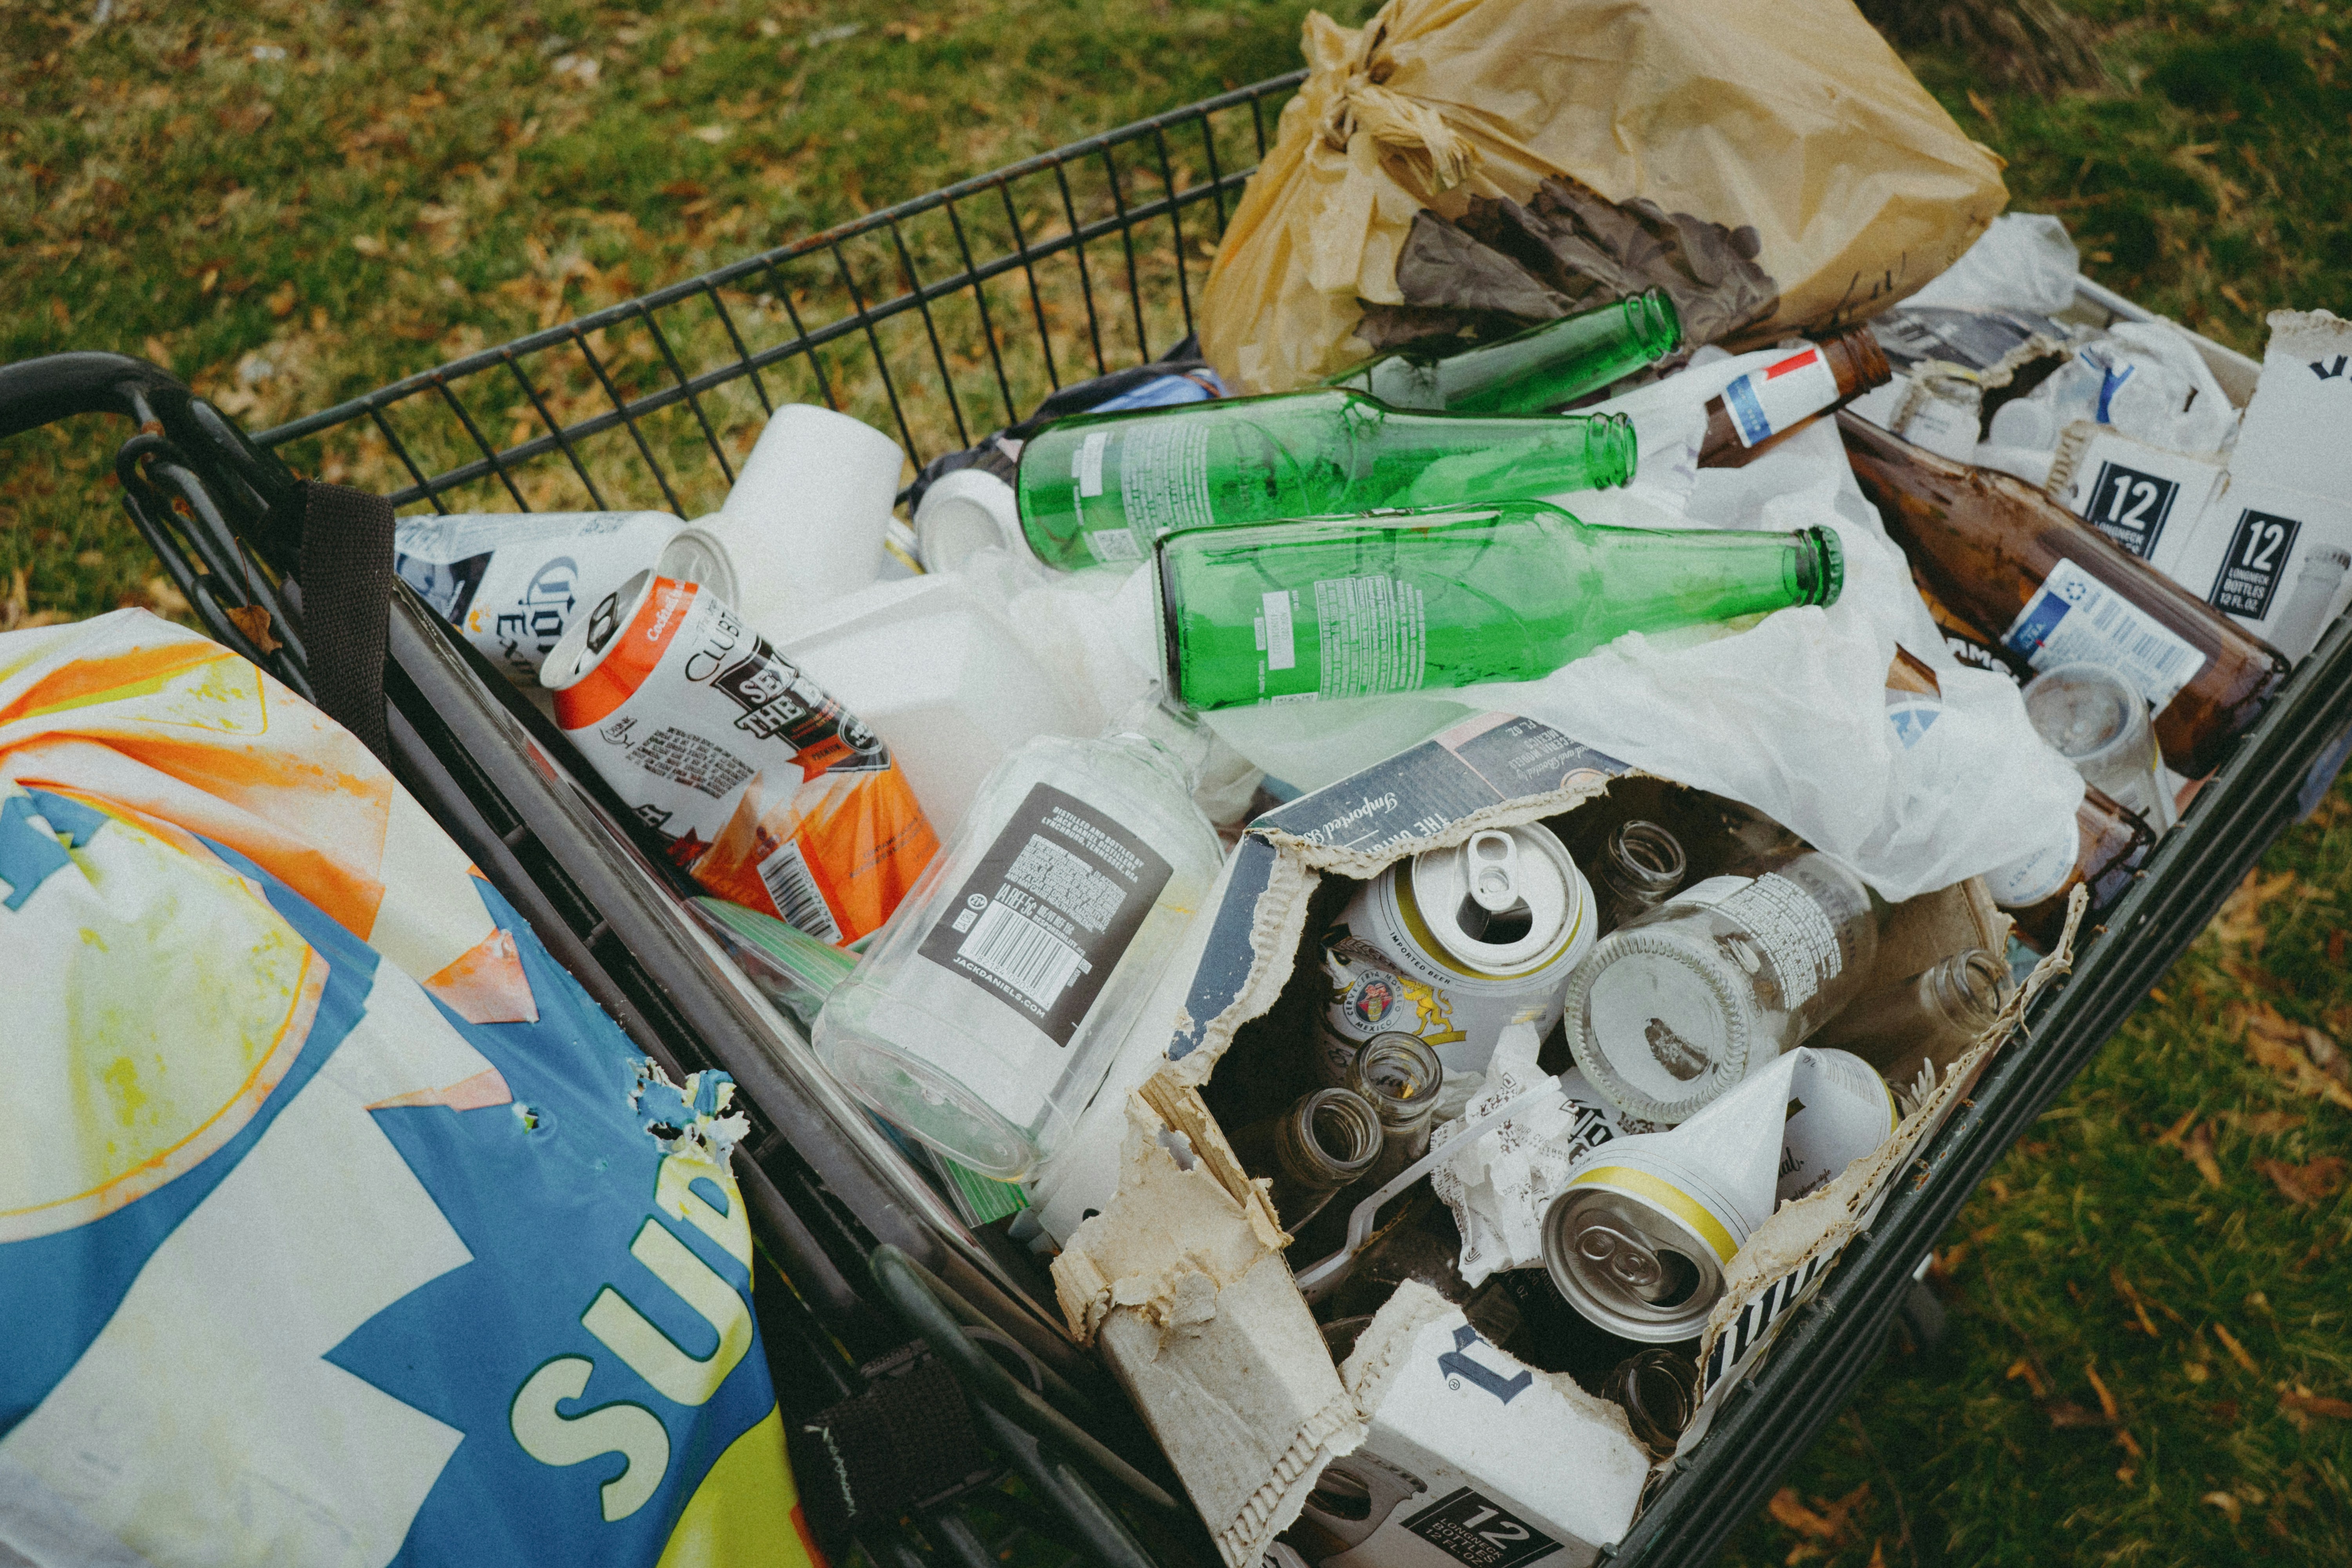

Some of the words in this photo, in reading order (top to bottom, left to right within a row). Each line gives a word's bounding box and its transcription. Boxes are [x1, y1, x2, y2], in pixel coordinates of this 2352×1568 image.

[2103, 472, 2160, 532] 12
[2240, 518, 2286, 573] 12
[2223, 577, 2265, 600] BOTTLES
[2228, 566, 2270, 586] LONGNECK
[2219, 592, 2232, 605] 12
[739, 652, 798, 706] SEX
[739, 697, 804, 739] THE
[1505, 724, 1523, 736] OZ.
[1523, 728, 1559, 750] MEXICO
[1508, 748, 1541, 769] MODELO
[1525, 757, 1560, 779] Bottled
[1557, 750, 1574, 765] and
[1321, 791, 1397, 839] Imported
[1413, 813, 1450, 838] THE
[1041, 817, 1087, 846] LYNCHBURG,
[1085, 841, 1127, 874] TENNESSEE,
[1124, 869, 1139, 883] USA
[1052, 806, 1091, 830] DISTILLED
[1089, 826, 1106, 840] AND
[1104, 836, 1136, 861] BOTTLED
[1133, 857, 1144, 868] BY
[1053, 814, 1073, 829] JACK
[1071, 825, 1099, 844] DANIEL
[1097, 840, 1137, 871] DISTILLERY
[1024, 844, 1036, 854] NOT
[1034, 849, 1051, 862] DRINK
[1049, 858, 1076, 877] ALCOHOLIC
[1074, 873, 1102, 896] BEVERAGES
[1100, 892, 1120, 909] DURING
[1031, 833, 1068, 857] GOVERNMENT
[1100, 875, 1127, 898] ACCORDING
[1034, 842, 1046, 851] THE
[1044, 847, 1068, 864] SURGEON
[1087, 874, 1107, 891] WOMEN
[1105, 887, 1124, 904] SHOULD
[1051, 866, 1074, 883] BECAUSE
[1072, 880, 1080, 888] OF
[1078, 884, 1088, 893] THE
[1086, 890, 1098, 901] RISK
[1096, 897, 1105, 906] OF
[969, 895, 985, 908] 21+
[995, 882, 1013, 902] IA
[1004, 887, 1028, 911] REF
[1004, 871, 1018, 882] AND
[1016, 878, 1031, 889] MAY
[1029, 885, 1049, 900] CAUSE
[1046, 895, 1067, 912] HEALTH
[1065, 908, 1095, 933] PROBLEMS.
[1009, 866, 1027, 879] DRIVE
[1030, 877, 1044, 888] CAR
[1042, 884, 1053, 893] OR
[1051, 889, 1076, 909] OPERATE
[1074, 906, 1108, 935] MACHINERY,
[1013, 860, 1045, 881] BEVERAGES
[1043, 877, 1068, 895] IMPAIRS
[1066, 892, 1083, 906] YOUR
[1081, 902, 1102, 919] ABILITY
[1100, 916, 1110, 926] TO
[1045, 871, 1082, 897] CONSUMPTION
[1080, 893, 1089, 902] OF
[1087, 898, 1113, 920] ALCOHOLIC
[955, 920, 968, 931] CA
[1036, 904, 1056, 923] ME/VT
[1052, 915, 1067, 930] REF
[976, 955, 1005, 976] 82184
[1007, 974, 1037, 998] 09050
[1390, 932, 1426, 971] IMPORTED
[1427, 970, 1449, 984] BEER
[953, 955, 1047, 1018] JACKDANIELS.COM
[1346, 971, 1379, 1015] CERVECERIA
[1385, 973, 1401, 1011] MODELO
[1356, 1020, 1391, 1031] MEXICO
[1425, 1528, 1442, 1539] 12
[1442, 1539, 1459, 1553] FL.
[1463, 1551, 1484, 1567] OZ.
[1431, 1522, 1496, 1563] BOTTLES
[1440, 1518, 1503, 1558] LONGNECK
[1462, 1505, 1530, 1550] 12
